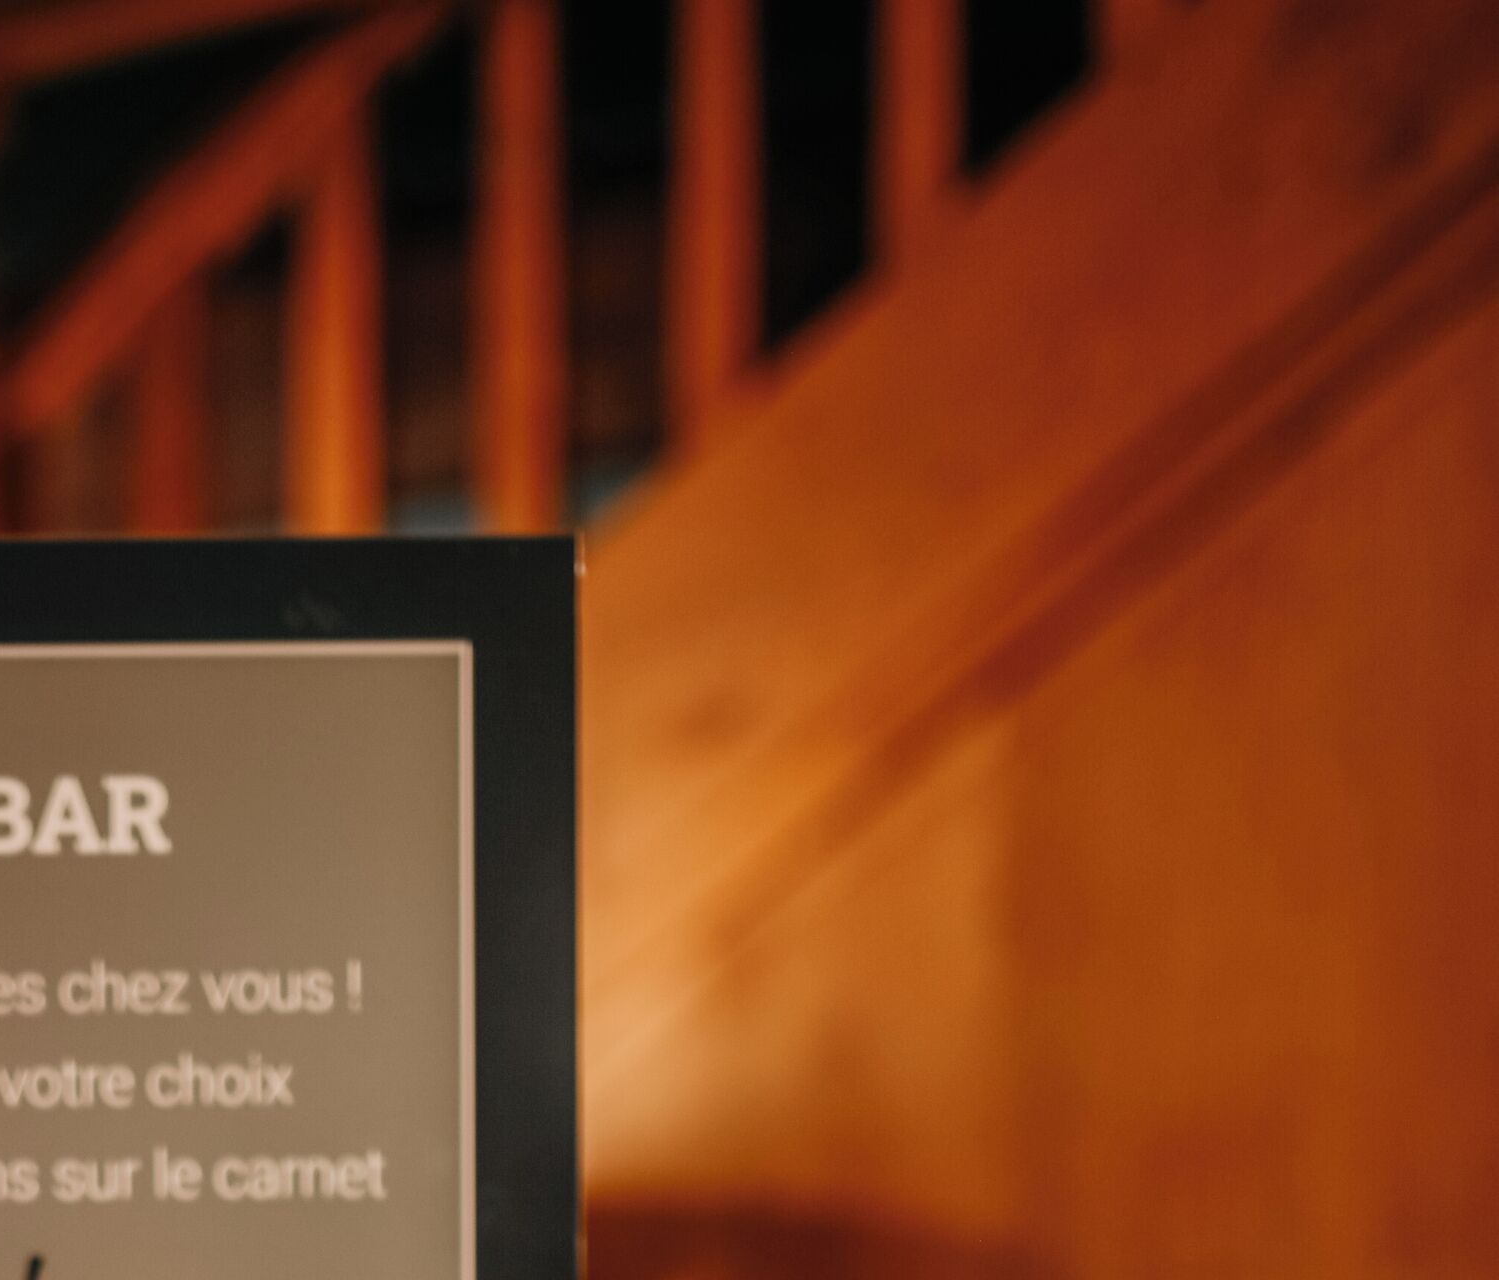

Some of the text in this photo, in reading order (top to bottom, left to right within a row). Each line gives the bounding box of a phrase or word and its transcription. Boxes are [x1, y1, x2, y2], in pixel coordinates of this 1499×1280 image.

[57, 957, 190, 1015] chez
[200, 968, 335, 1015] vous
[345, 957, 363, 1014] !
[144, 1051, 295, 1108] choix
[51, 1155, 143, 1202] sur
[152, 1144, 203, 1202] le
[212, 1147, 388, 1202] carnet
